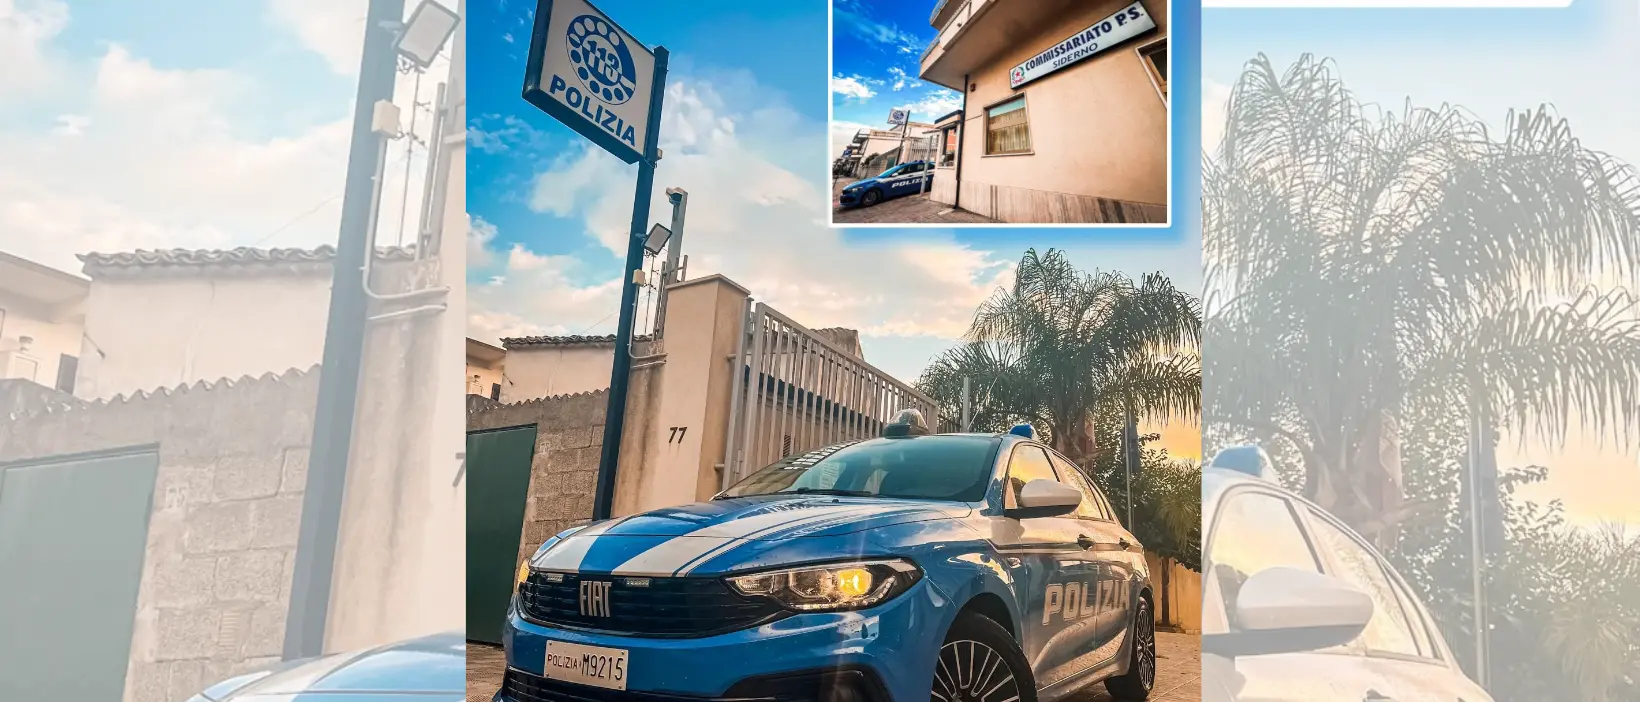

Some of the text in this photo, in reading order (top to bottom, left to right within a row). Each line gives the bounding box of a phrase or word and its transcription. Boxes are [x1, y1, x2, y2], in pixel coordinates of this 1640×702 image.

[1025, 6, 1144, 71] COMMISSARIATO P.S.
[1052, 42, 1098, 69] SIDERNO
[549, 74, 636, 147] POLIZIA
[668, 426, 688, 444] 77
[580, 580, 613, 618] FIAT
[1042, 579, 1130, 626] POLIZIA
[547, 653, 624, 681] POLIZIA M9215
